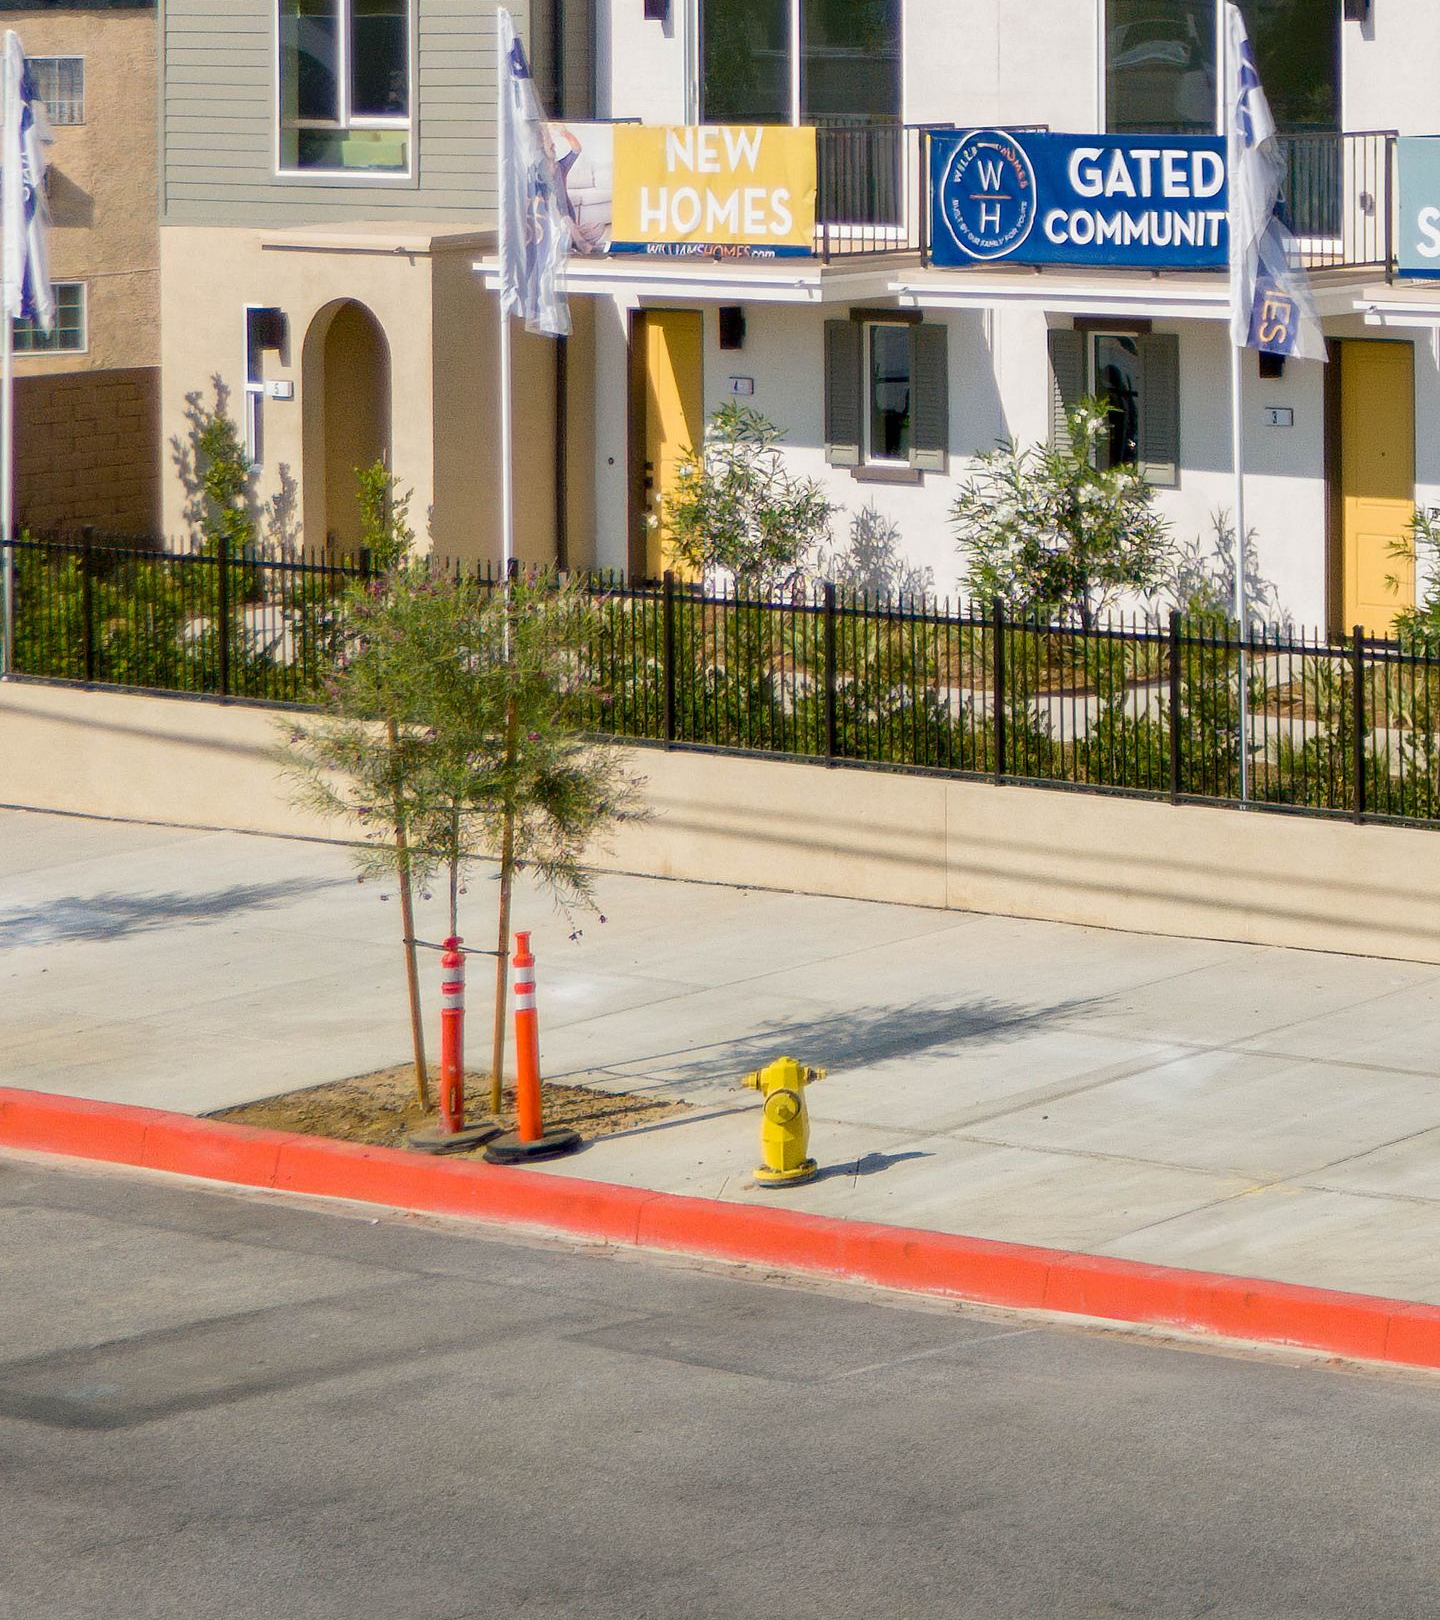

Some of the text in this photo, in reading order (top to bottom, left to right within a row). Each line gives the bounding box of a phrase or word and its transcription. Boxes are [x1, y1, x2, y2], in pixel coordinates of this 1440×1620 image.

[664, 126, 764, 174] NEW
[1069, 147, 1224, 199] GATED
[978, 159, 1004, 191] W
[640, 186, 793, 236] HOMES
[980, 202, 1001, 234] H
